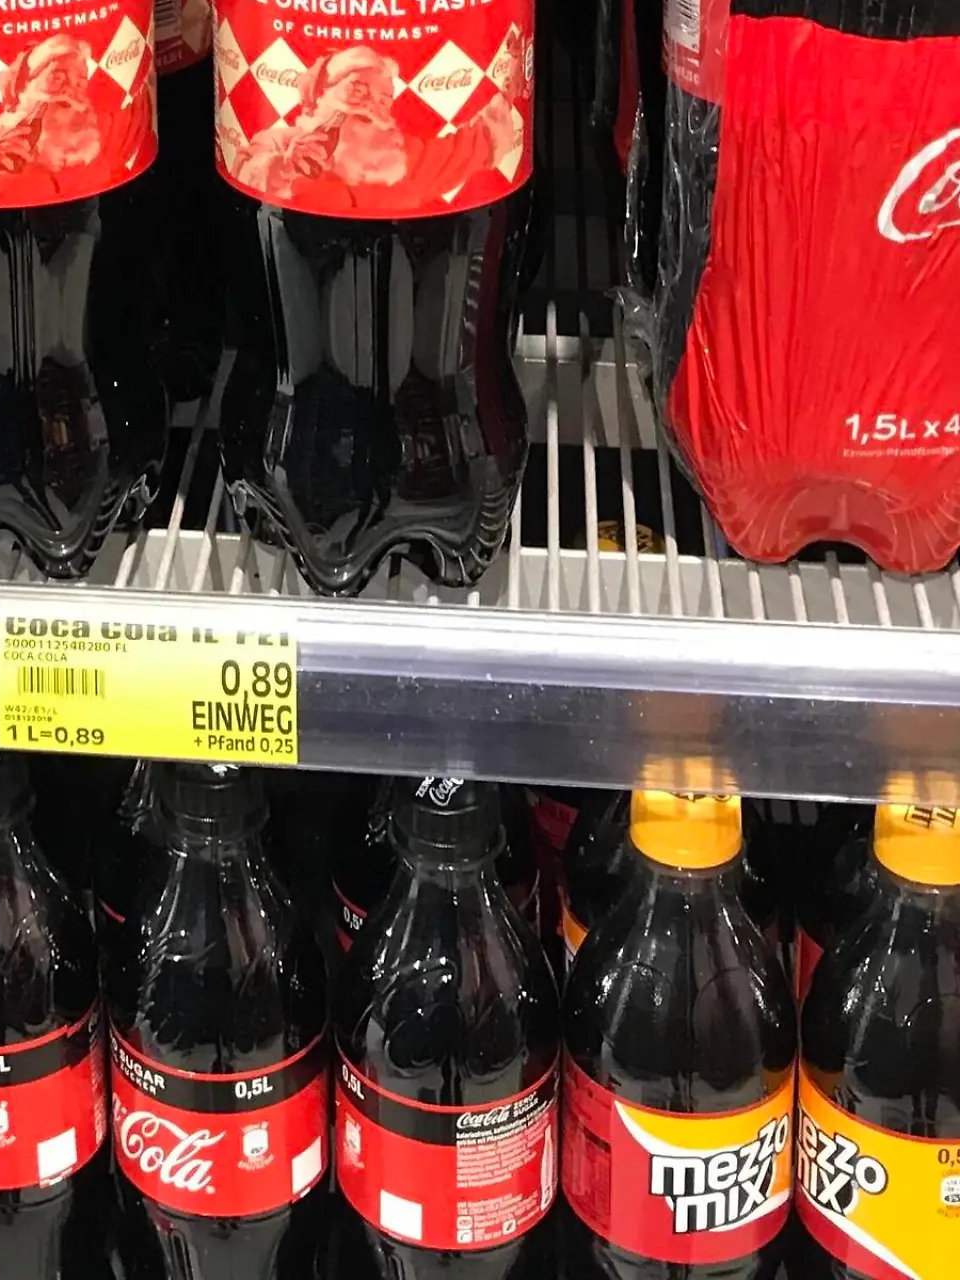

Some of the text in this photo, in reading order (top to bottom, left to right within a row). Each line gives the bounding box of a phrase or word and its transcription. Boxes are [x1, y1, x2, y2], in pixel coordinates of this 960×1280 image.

[273, 19, 294, 33] OF
[255, 65, 301, 90] Coca-Col
[845, 414, 960, 445] 1,5L x 4
[5, 616, 90, 639] Coca
[101, 621, 177, 642] Cola
[4, 651, 68, 663] COCA COLA
[221, 659, 292, 700] 0,89
[191, 701, 292, 734] EINWEG
[6, 725, 105, 747] 1 L=0,89
[208, 734, 255, 754] Pfand
[260, 736, 294, 755] 0,25
[343, 907, 363, 930] 0,5
[119, 1050, 165, 1091] SUGAR
[342, 1065, 364, 1100] 0,5L
[235, 1076, 274, 1100] 0,5L
[650, 1113, 789, 1196] mezzo
[799, 1110, 889, 1195] ezzo
[672, 1156, 774, 1235] mix
